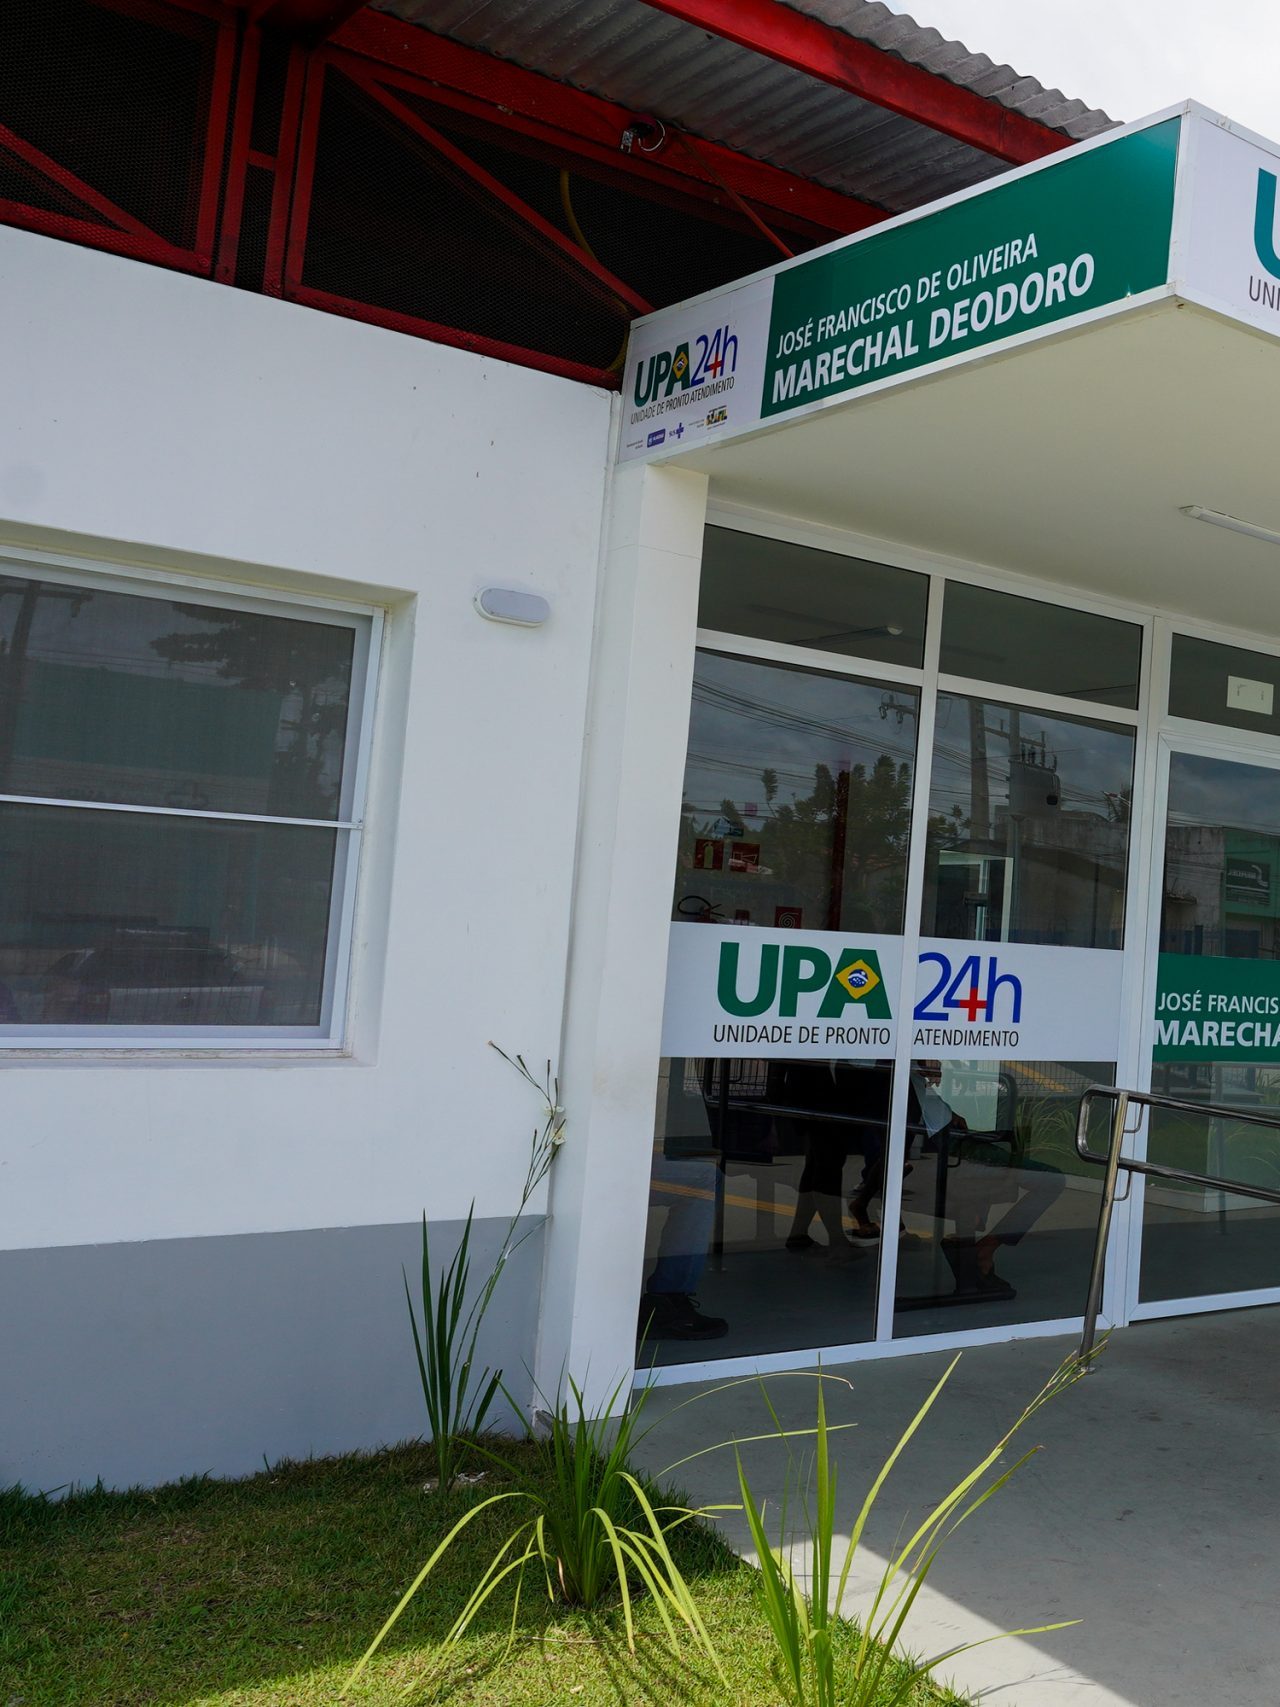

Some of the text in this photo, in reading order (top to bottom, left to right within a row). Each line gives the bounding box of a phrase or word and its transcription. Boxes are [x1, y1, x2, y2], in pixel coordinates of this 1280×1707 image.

[772, 253, 1095, 402] MARECHAL DEODORO
[776, 233, 1038, 359] JOSÉ FRANCISCO DE OLIVEIRA
[631, 376, 735, 425] UNIDADE DE PRONTO ATENDIMENTO
[634, 325, 738, 408] UPA 24h
[717, 941, 1023, 1024] UPA 24h
[1158, 989, 1202, 1012] JOSÉ
[713, 1024, 1019, 1048] UNIDADE DE PRONTO ATENDIMENTO
